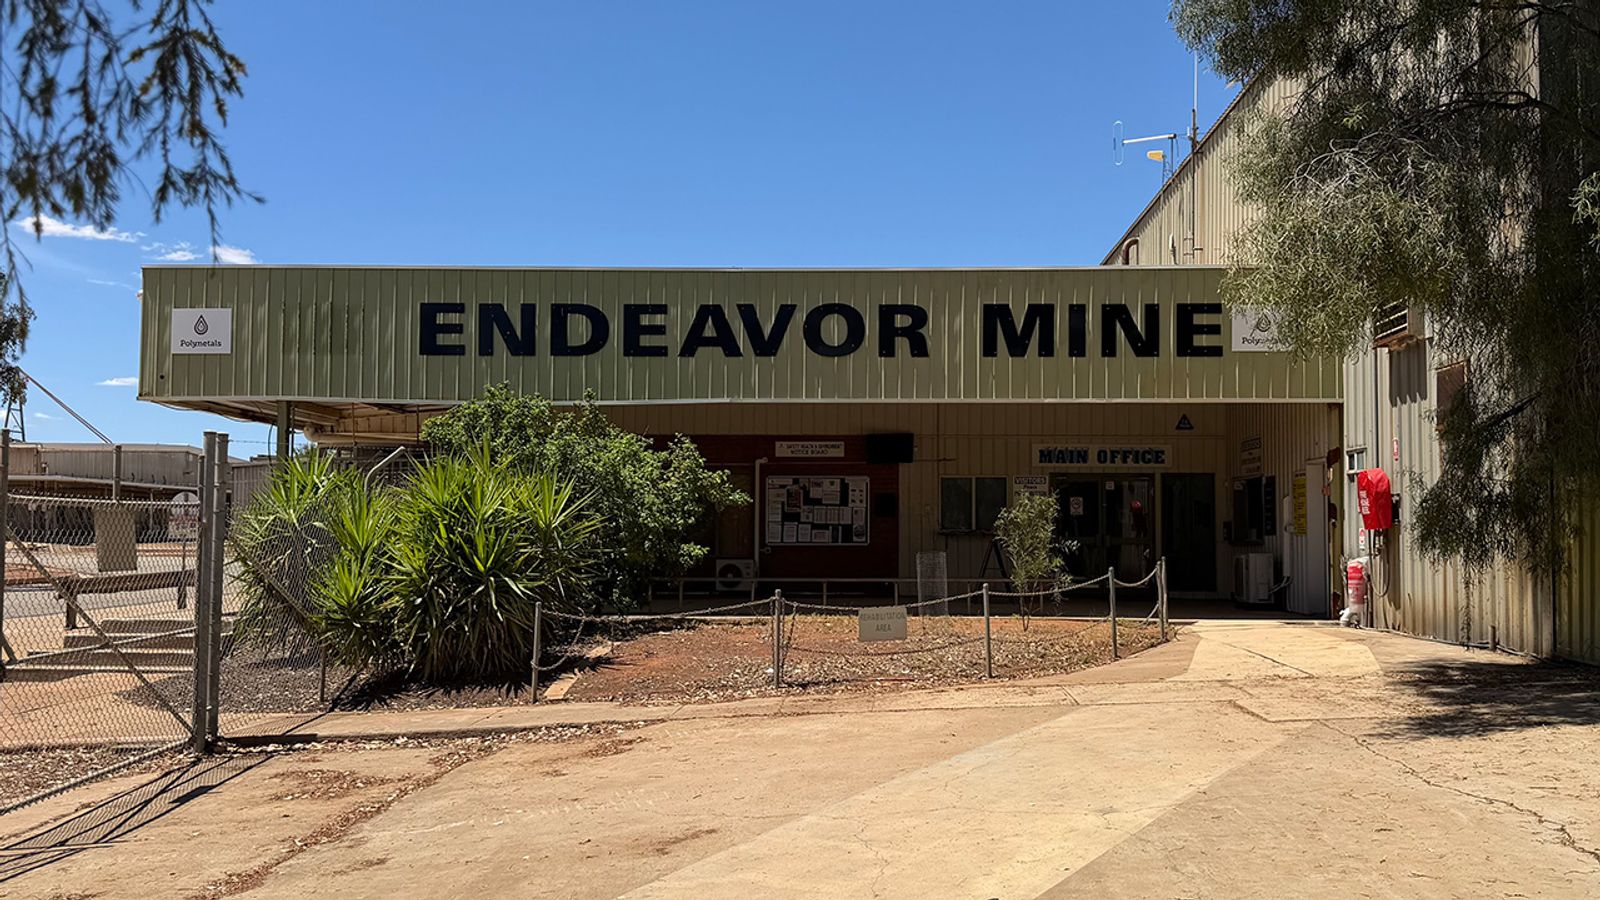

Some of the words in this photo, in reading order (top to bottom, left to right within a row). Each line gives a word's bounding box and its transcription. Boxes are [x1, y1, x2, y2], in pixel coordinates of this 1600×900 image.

[419, 302, 929, 358] ENDEAVOR
[982, 303, 1224, 358] MINE
[180, 339, 222, 348] Polymetals
[1038, 447, 1089, 465] MAIN
[1096, 447, 1166, 465] OFFICE
[1015, 477, 1046, 485] VISITORS
[860, 611, 907, 621] REHABILITATION
[875, 623, 892, 632] AREA
